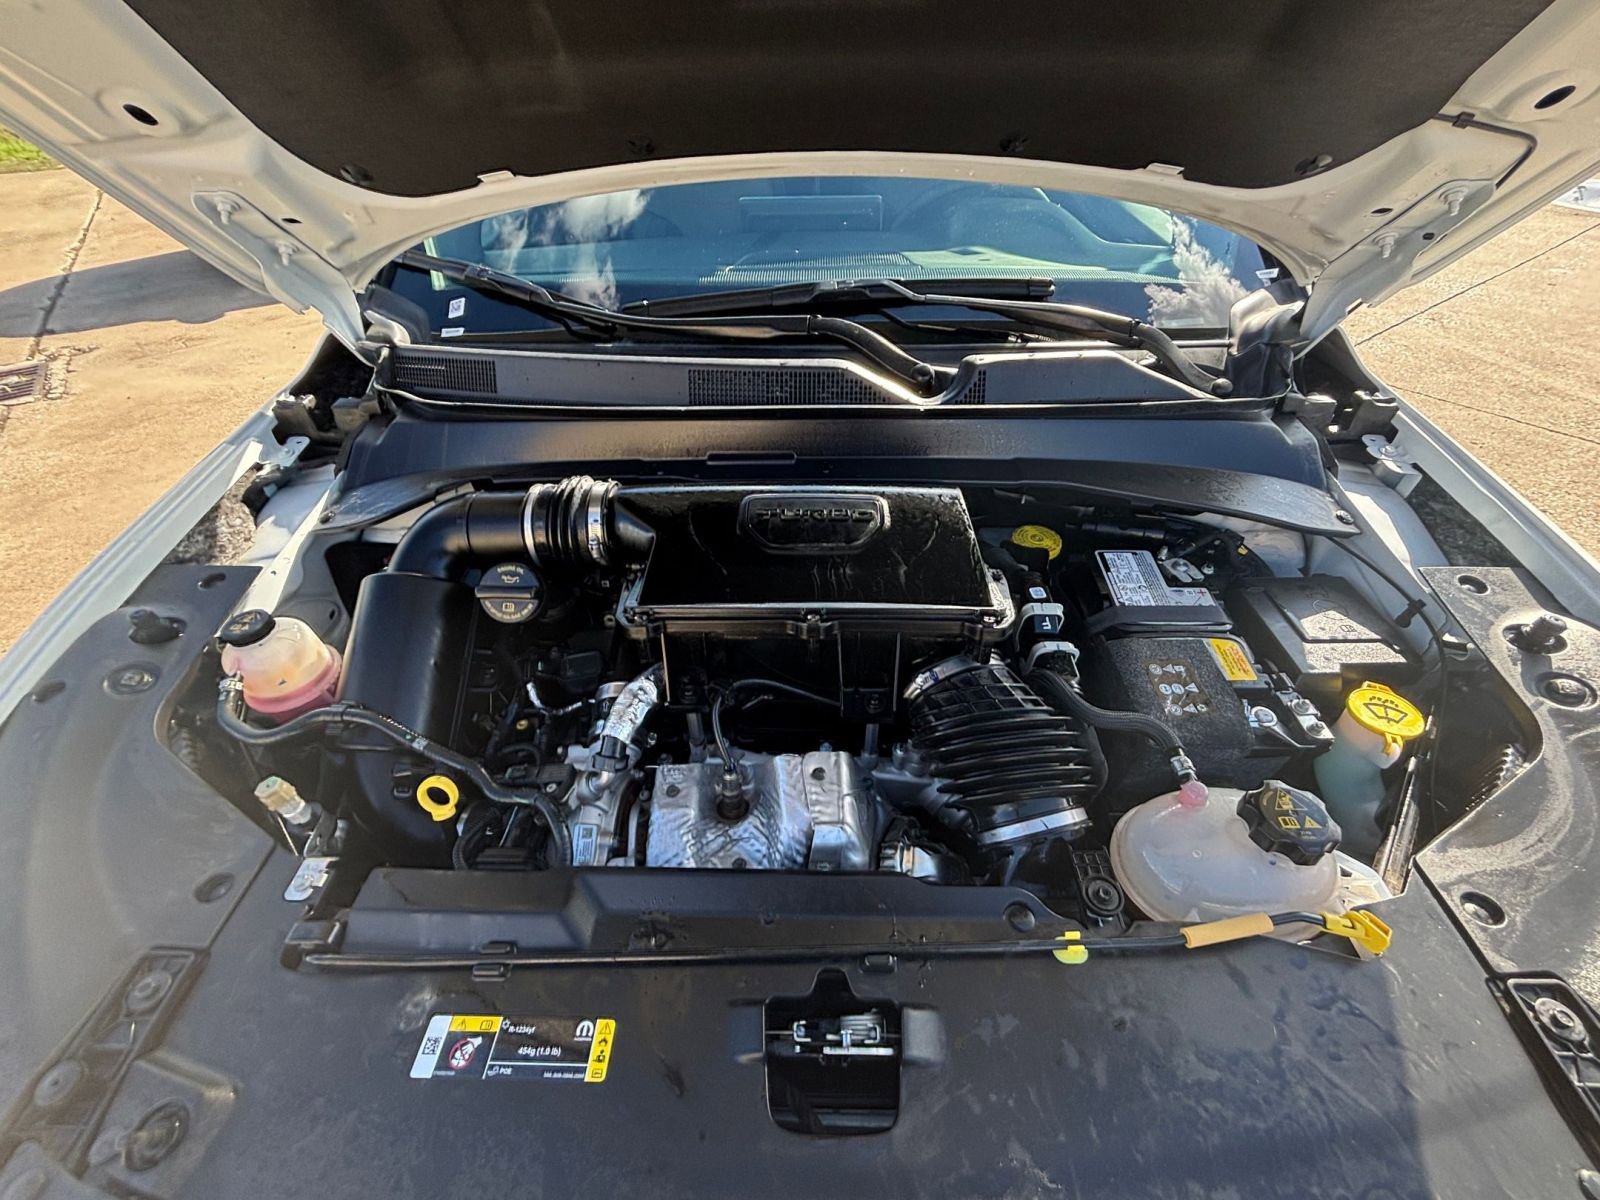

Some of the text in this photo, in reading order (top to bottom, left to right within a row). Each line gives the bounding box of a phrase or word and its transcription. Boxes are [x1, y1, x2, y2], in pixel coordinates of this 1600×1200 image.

[755, 508, 875, 520] TURBO
[517, 1046, 562, 1057] 454g (1.0 lb)
